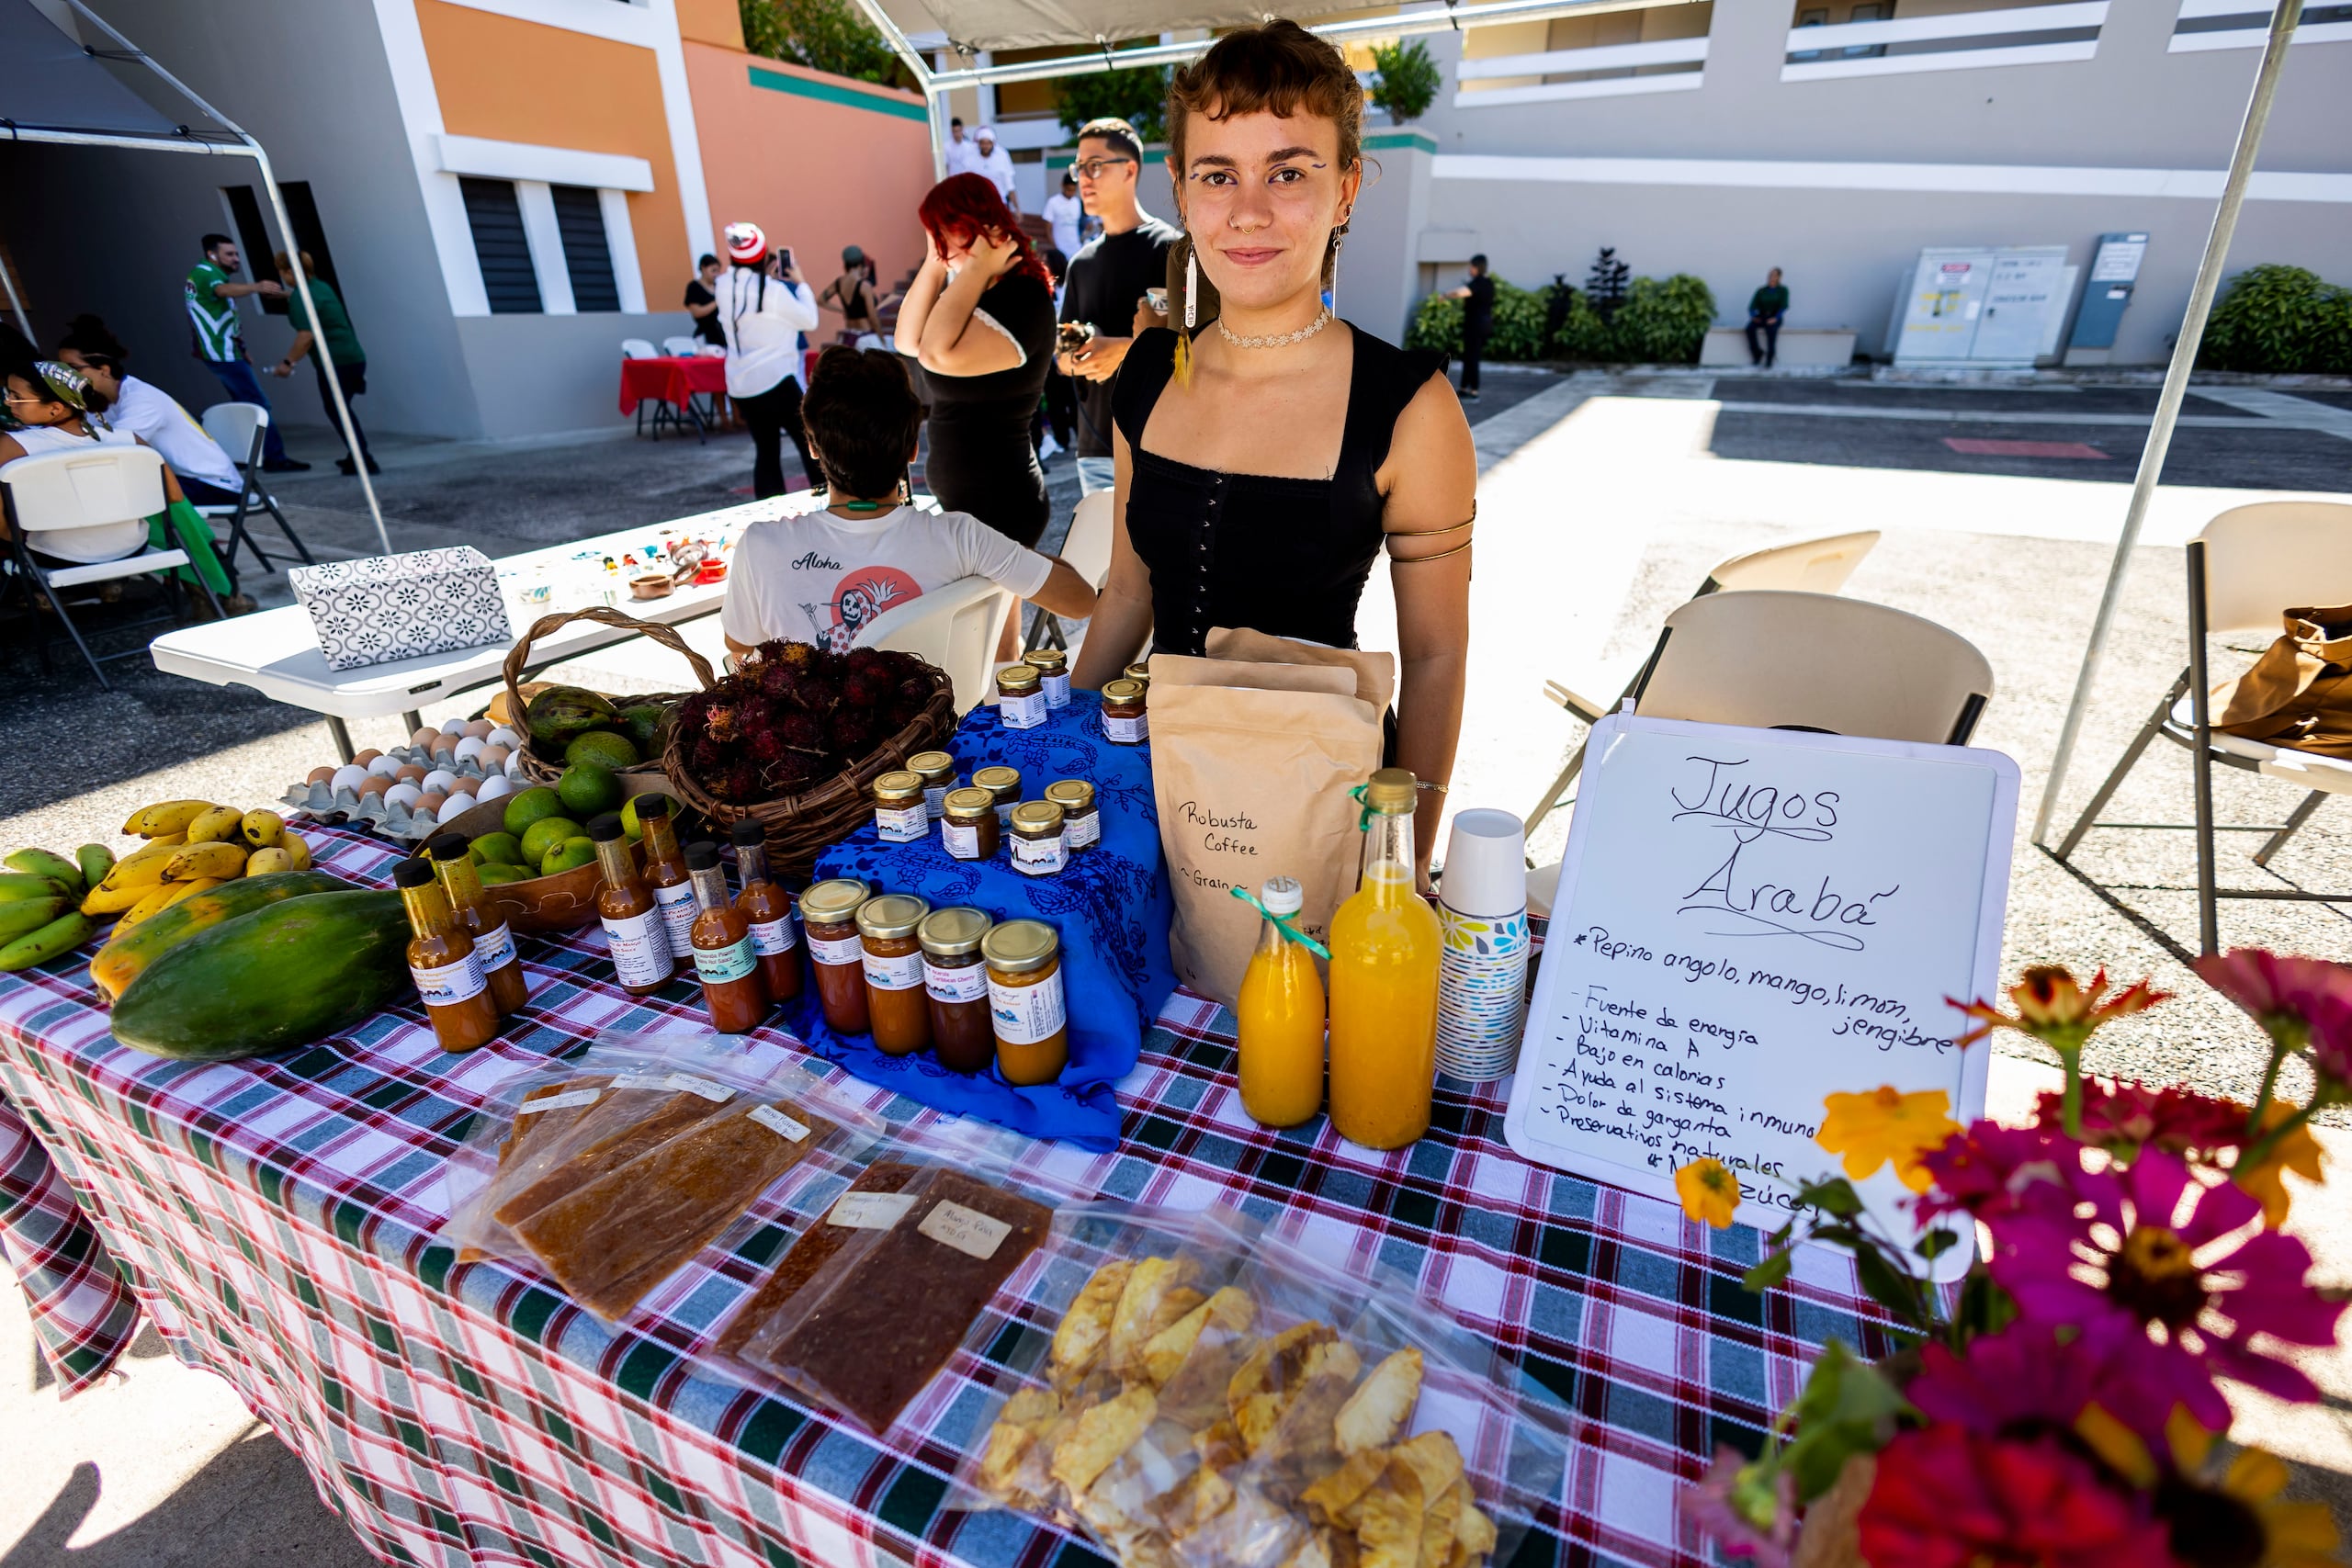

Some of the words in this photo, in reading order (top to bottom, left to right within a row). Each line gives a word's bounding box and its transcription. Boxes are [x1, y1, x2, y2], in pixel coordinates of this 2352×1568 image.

[791, 551, 844, 570] Aloha
[1178, 800, 1259, 829] Robusta
[1671, 756, 1839, 842] Jugos
[1204, 832, 1259, 855] Coffee
[1193, 869, 1228, 889] Grain
[1589, 926, 1653, 961] Pepino
[1586, 985, 1647, 1019] Fuente
[1656, 1007, 1679, 1028] de
[1577, 1034, 1616, 1066] Bajo
[1623, 1055, 1644, 1069] en
[1579, 1015, 1668, 1052] Vitamina
[1687, 1038, 1700, 1058] A
[1832, 1016, 1953, 1055] jengibre
[1562, 1058, 1617, 1089] Ayuda
[1625, 1077, 1644, 1094] al
[1557, 1083, 1606, 1109] Dolor
[1617, 1100, 1637, 1117] de
[1642, 1110, 1731, 1139] garganta
